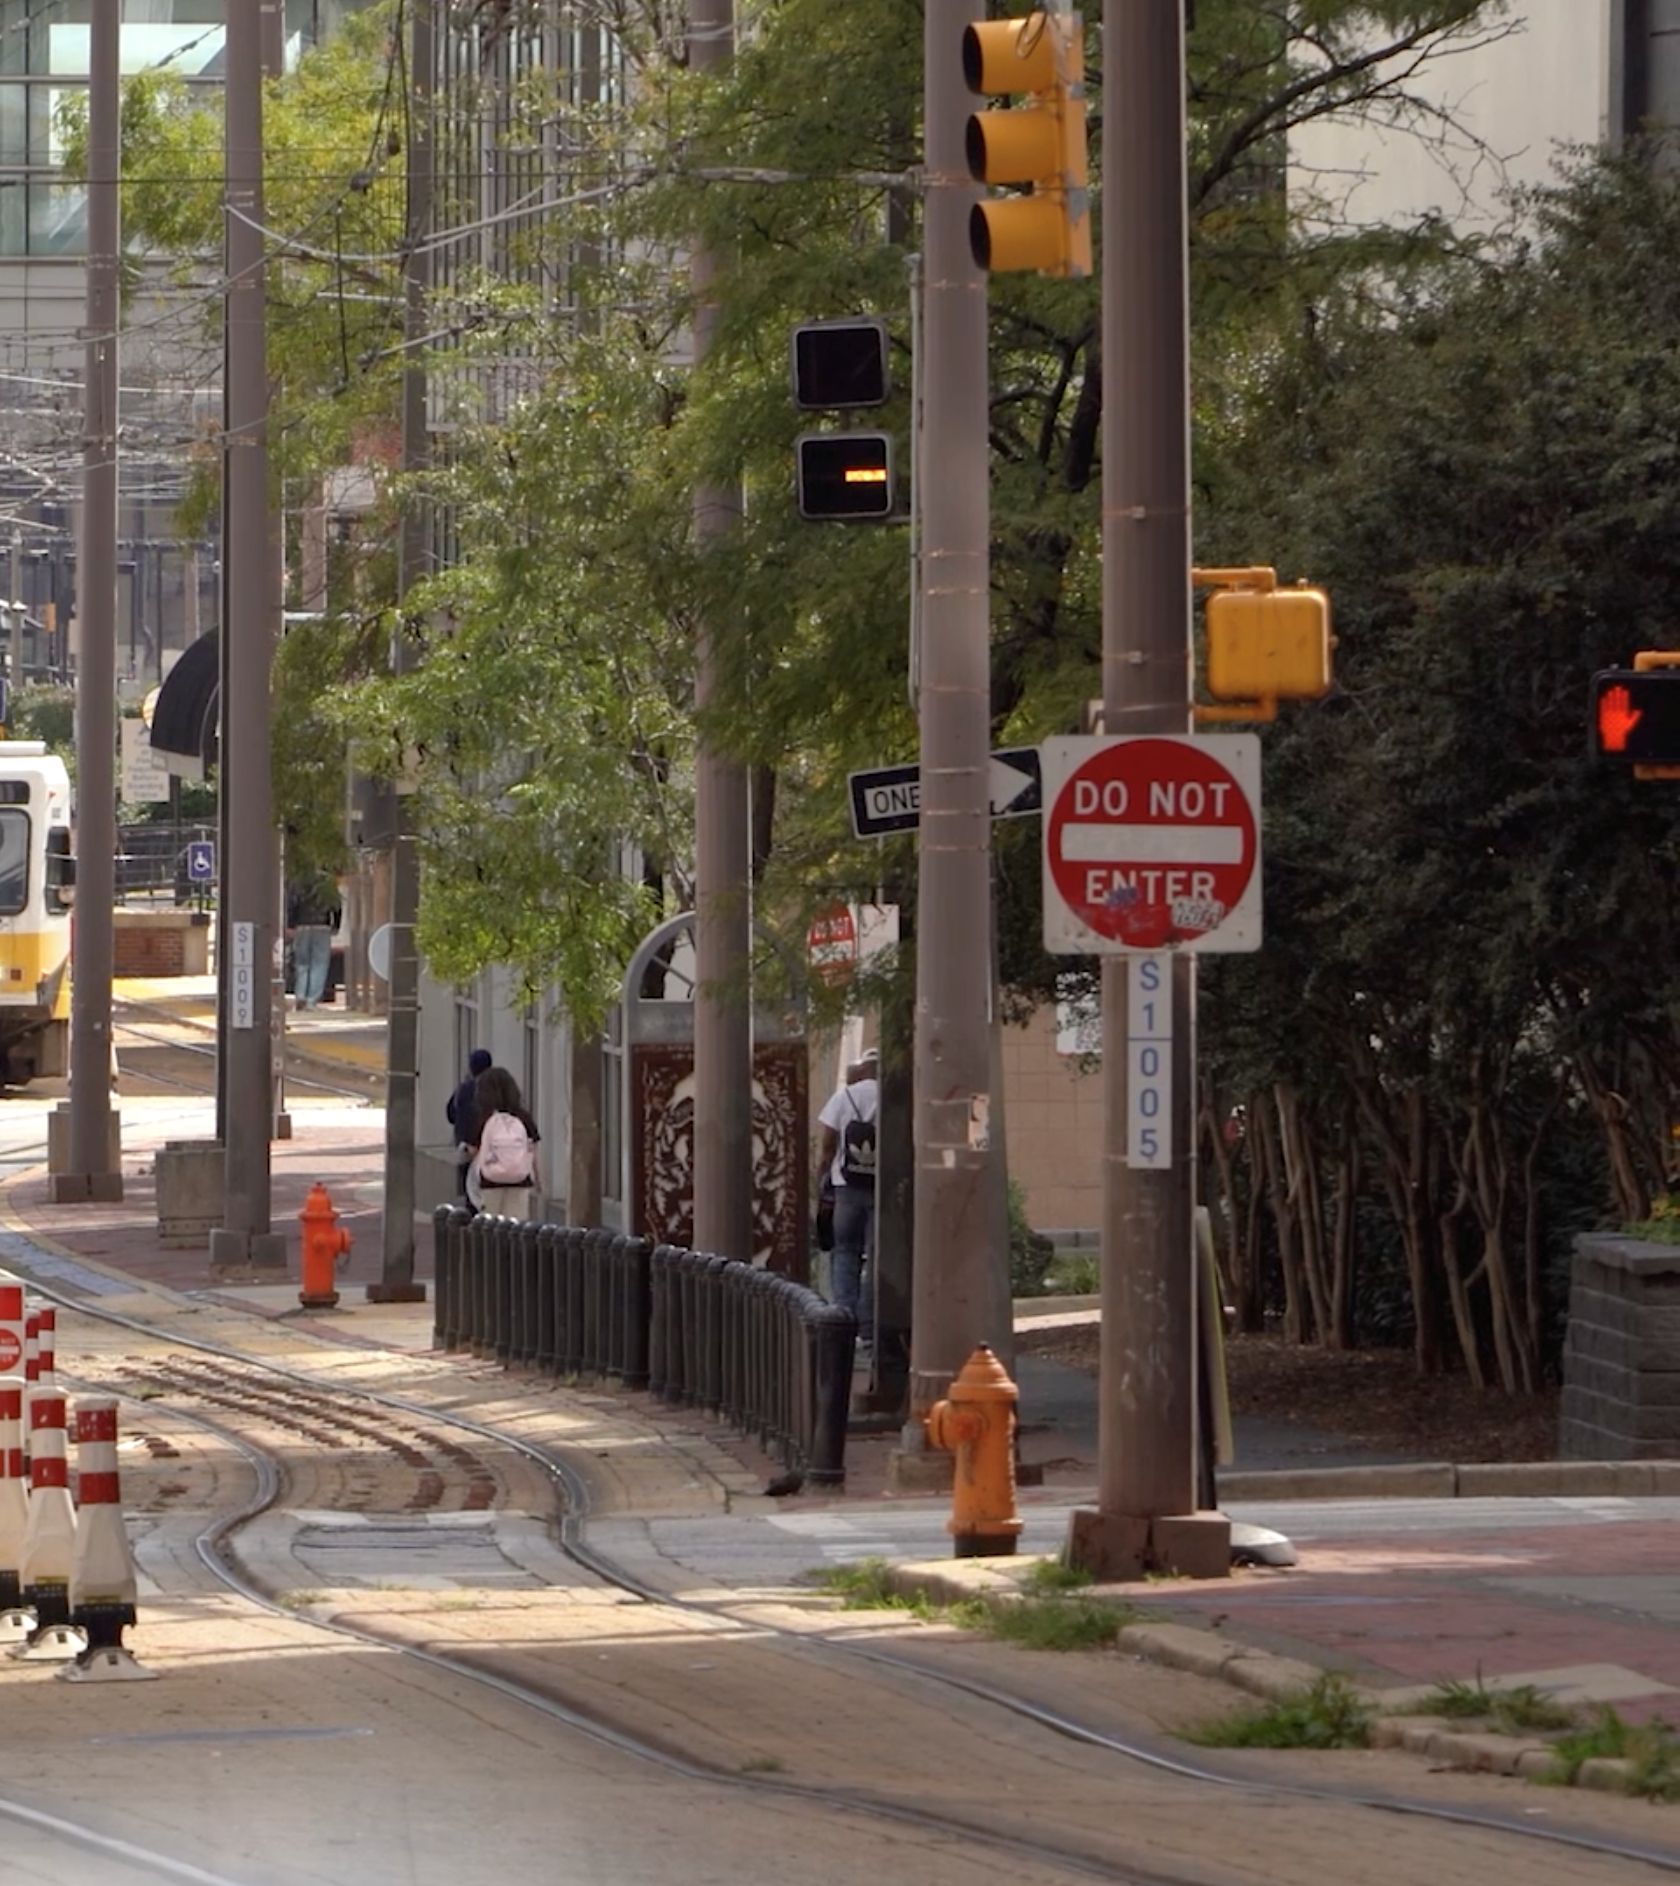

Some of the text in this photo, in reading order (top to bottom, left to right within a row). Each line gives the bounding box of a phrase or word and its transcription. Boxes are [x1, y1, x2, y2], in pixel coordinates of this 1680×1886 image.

[873, 786, 920, 814] ONE
[1074, 780, 1232, 819] DO NOT
[1086, 869, 1216, 906] ENTER
[1140, 960, 1160, 1159] S1005
